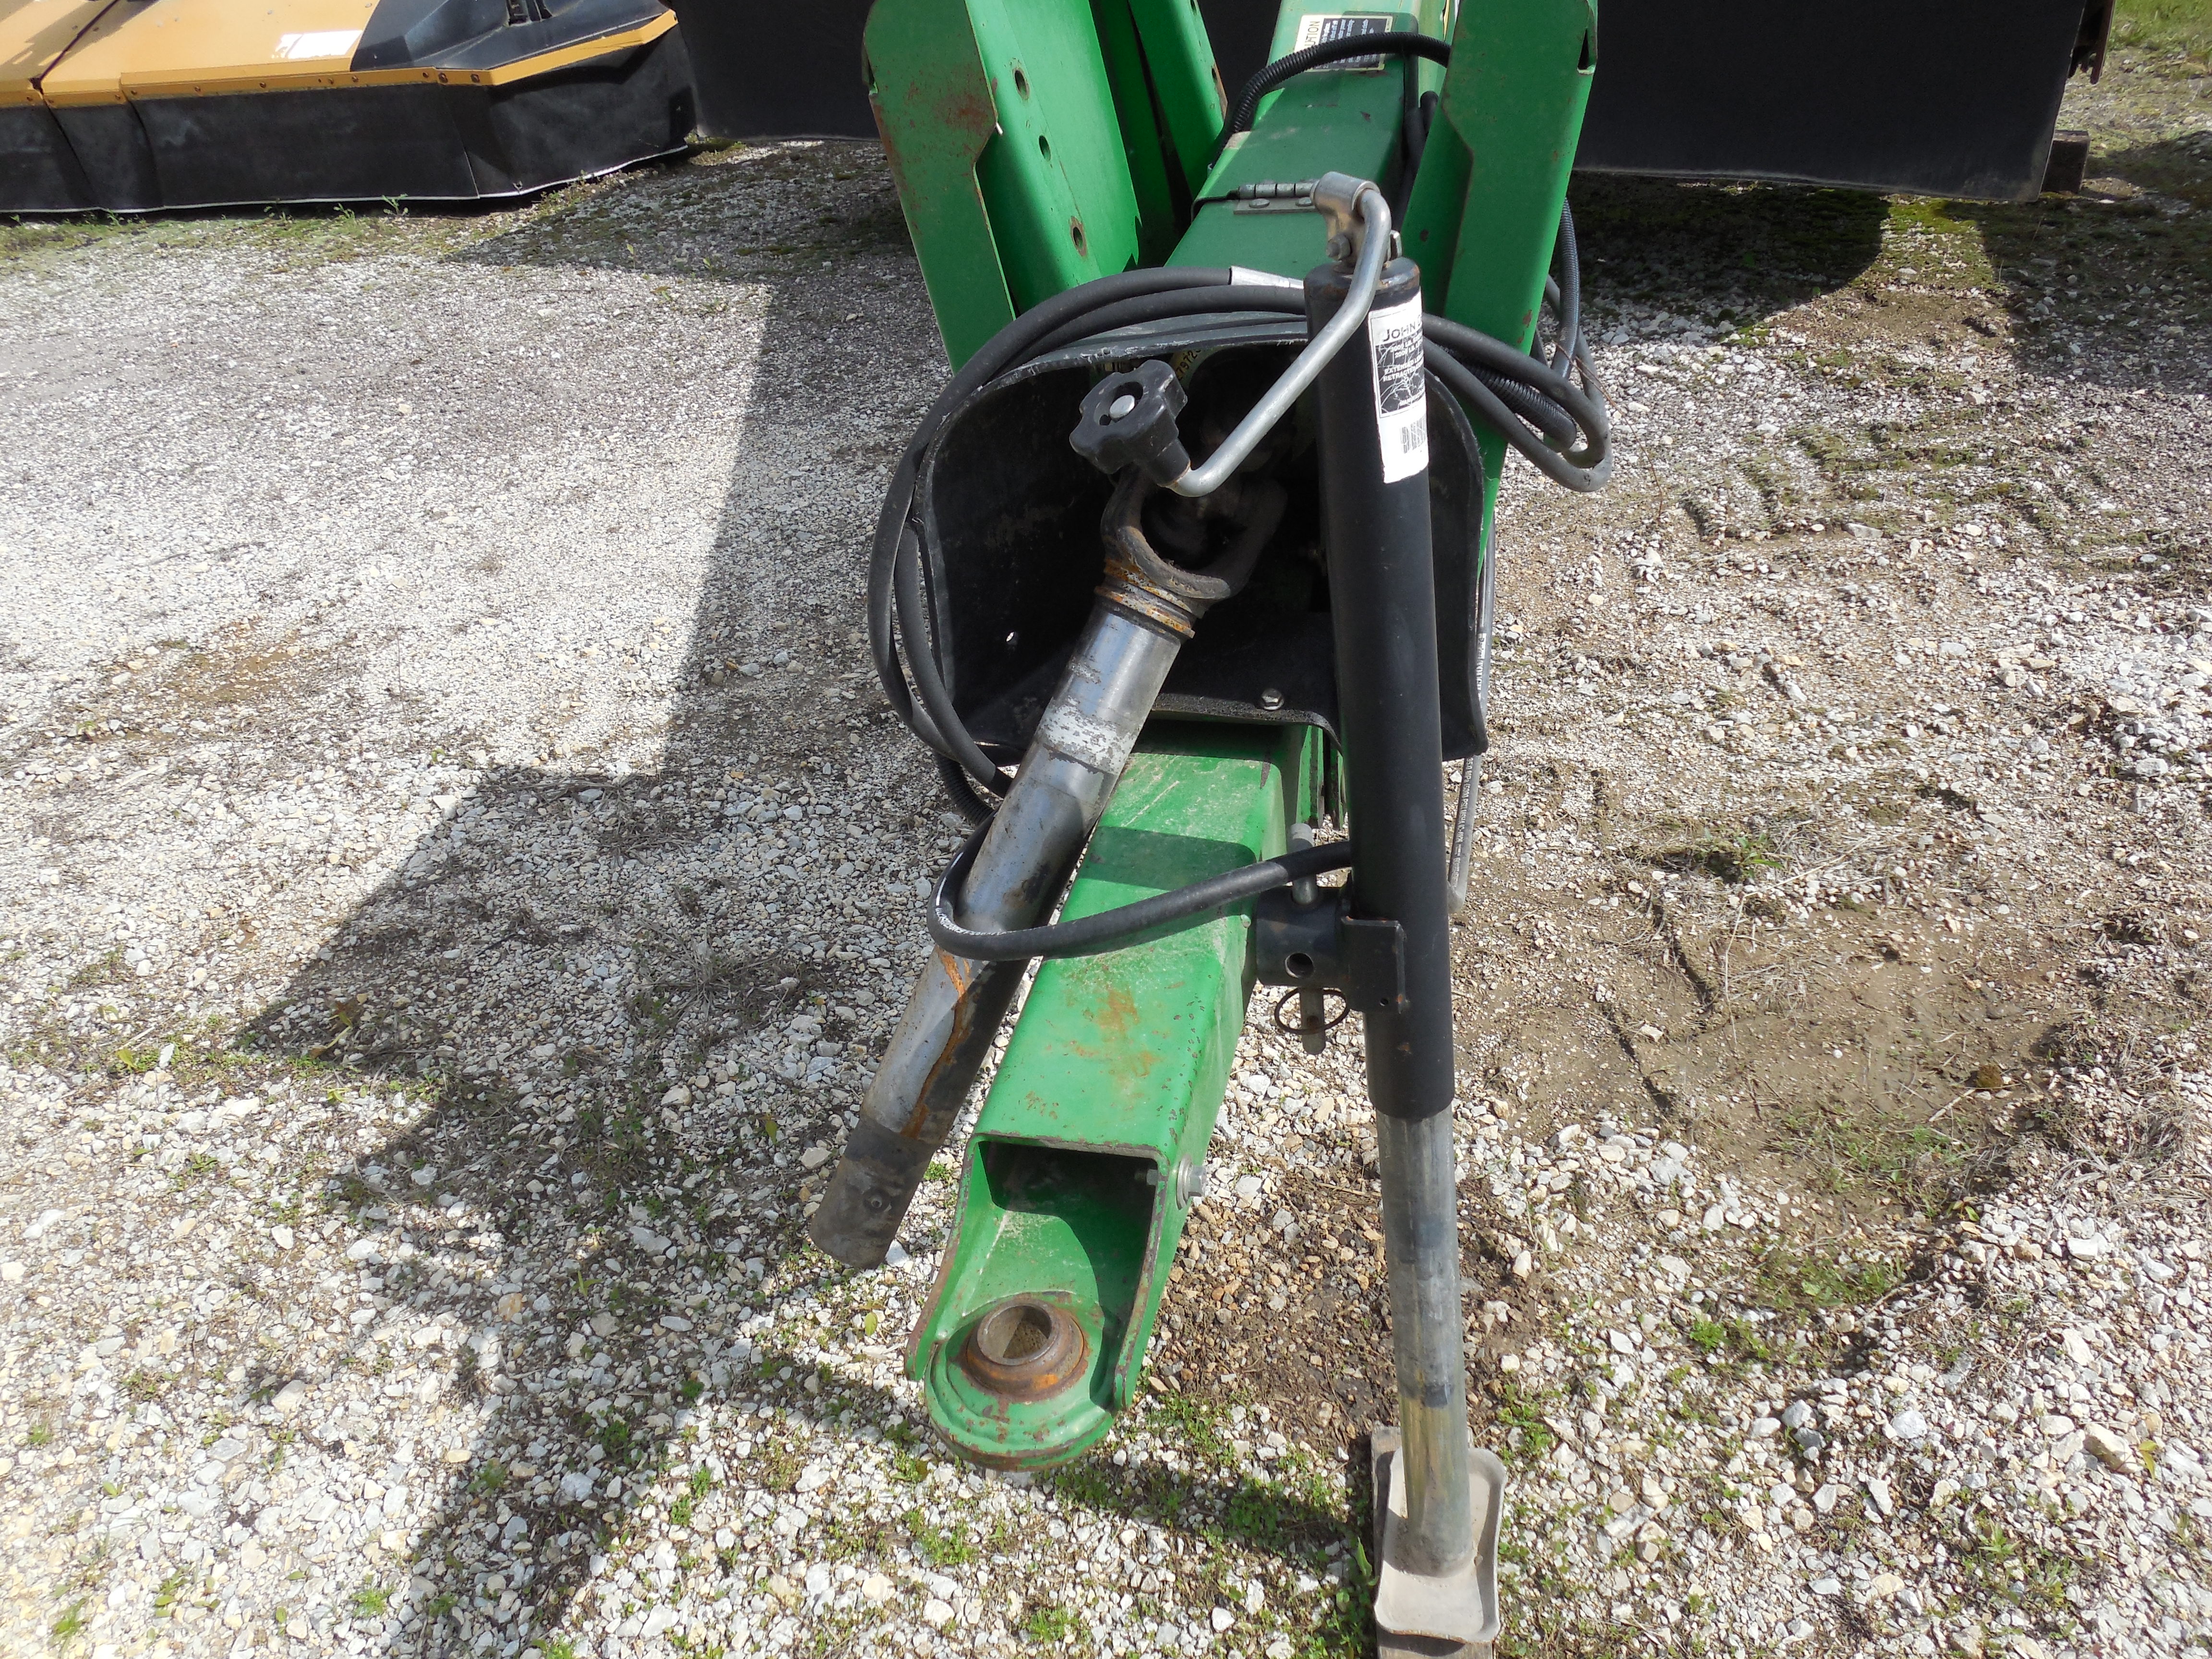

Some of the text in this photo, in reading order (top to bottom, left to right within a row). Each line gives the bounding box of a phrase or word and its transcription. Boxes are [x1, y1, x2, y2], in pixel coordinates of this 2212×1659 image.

[1304, 21, 1320, 46] UTION
[1383, 321, 1416, 342] JOHN
[1395, 348, 1408, 358] 2000
[1464, 770, 1472, 782] MPa
[1458, 810, 1467, 824] MSHA
